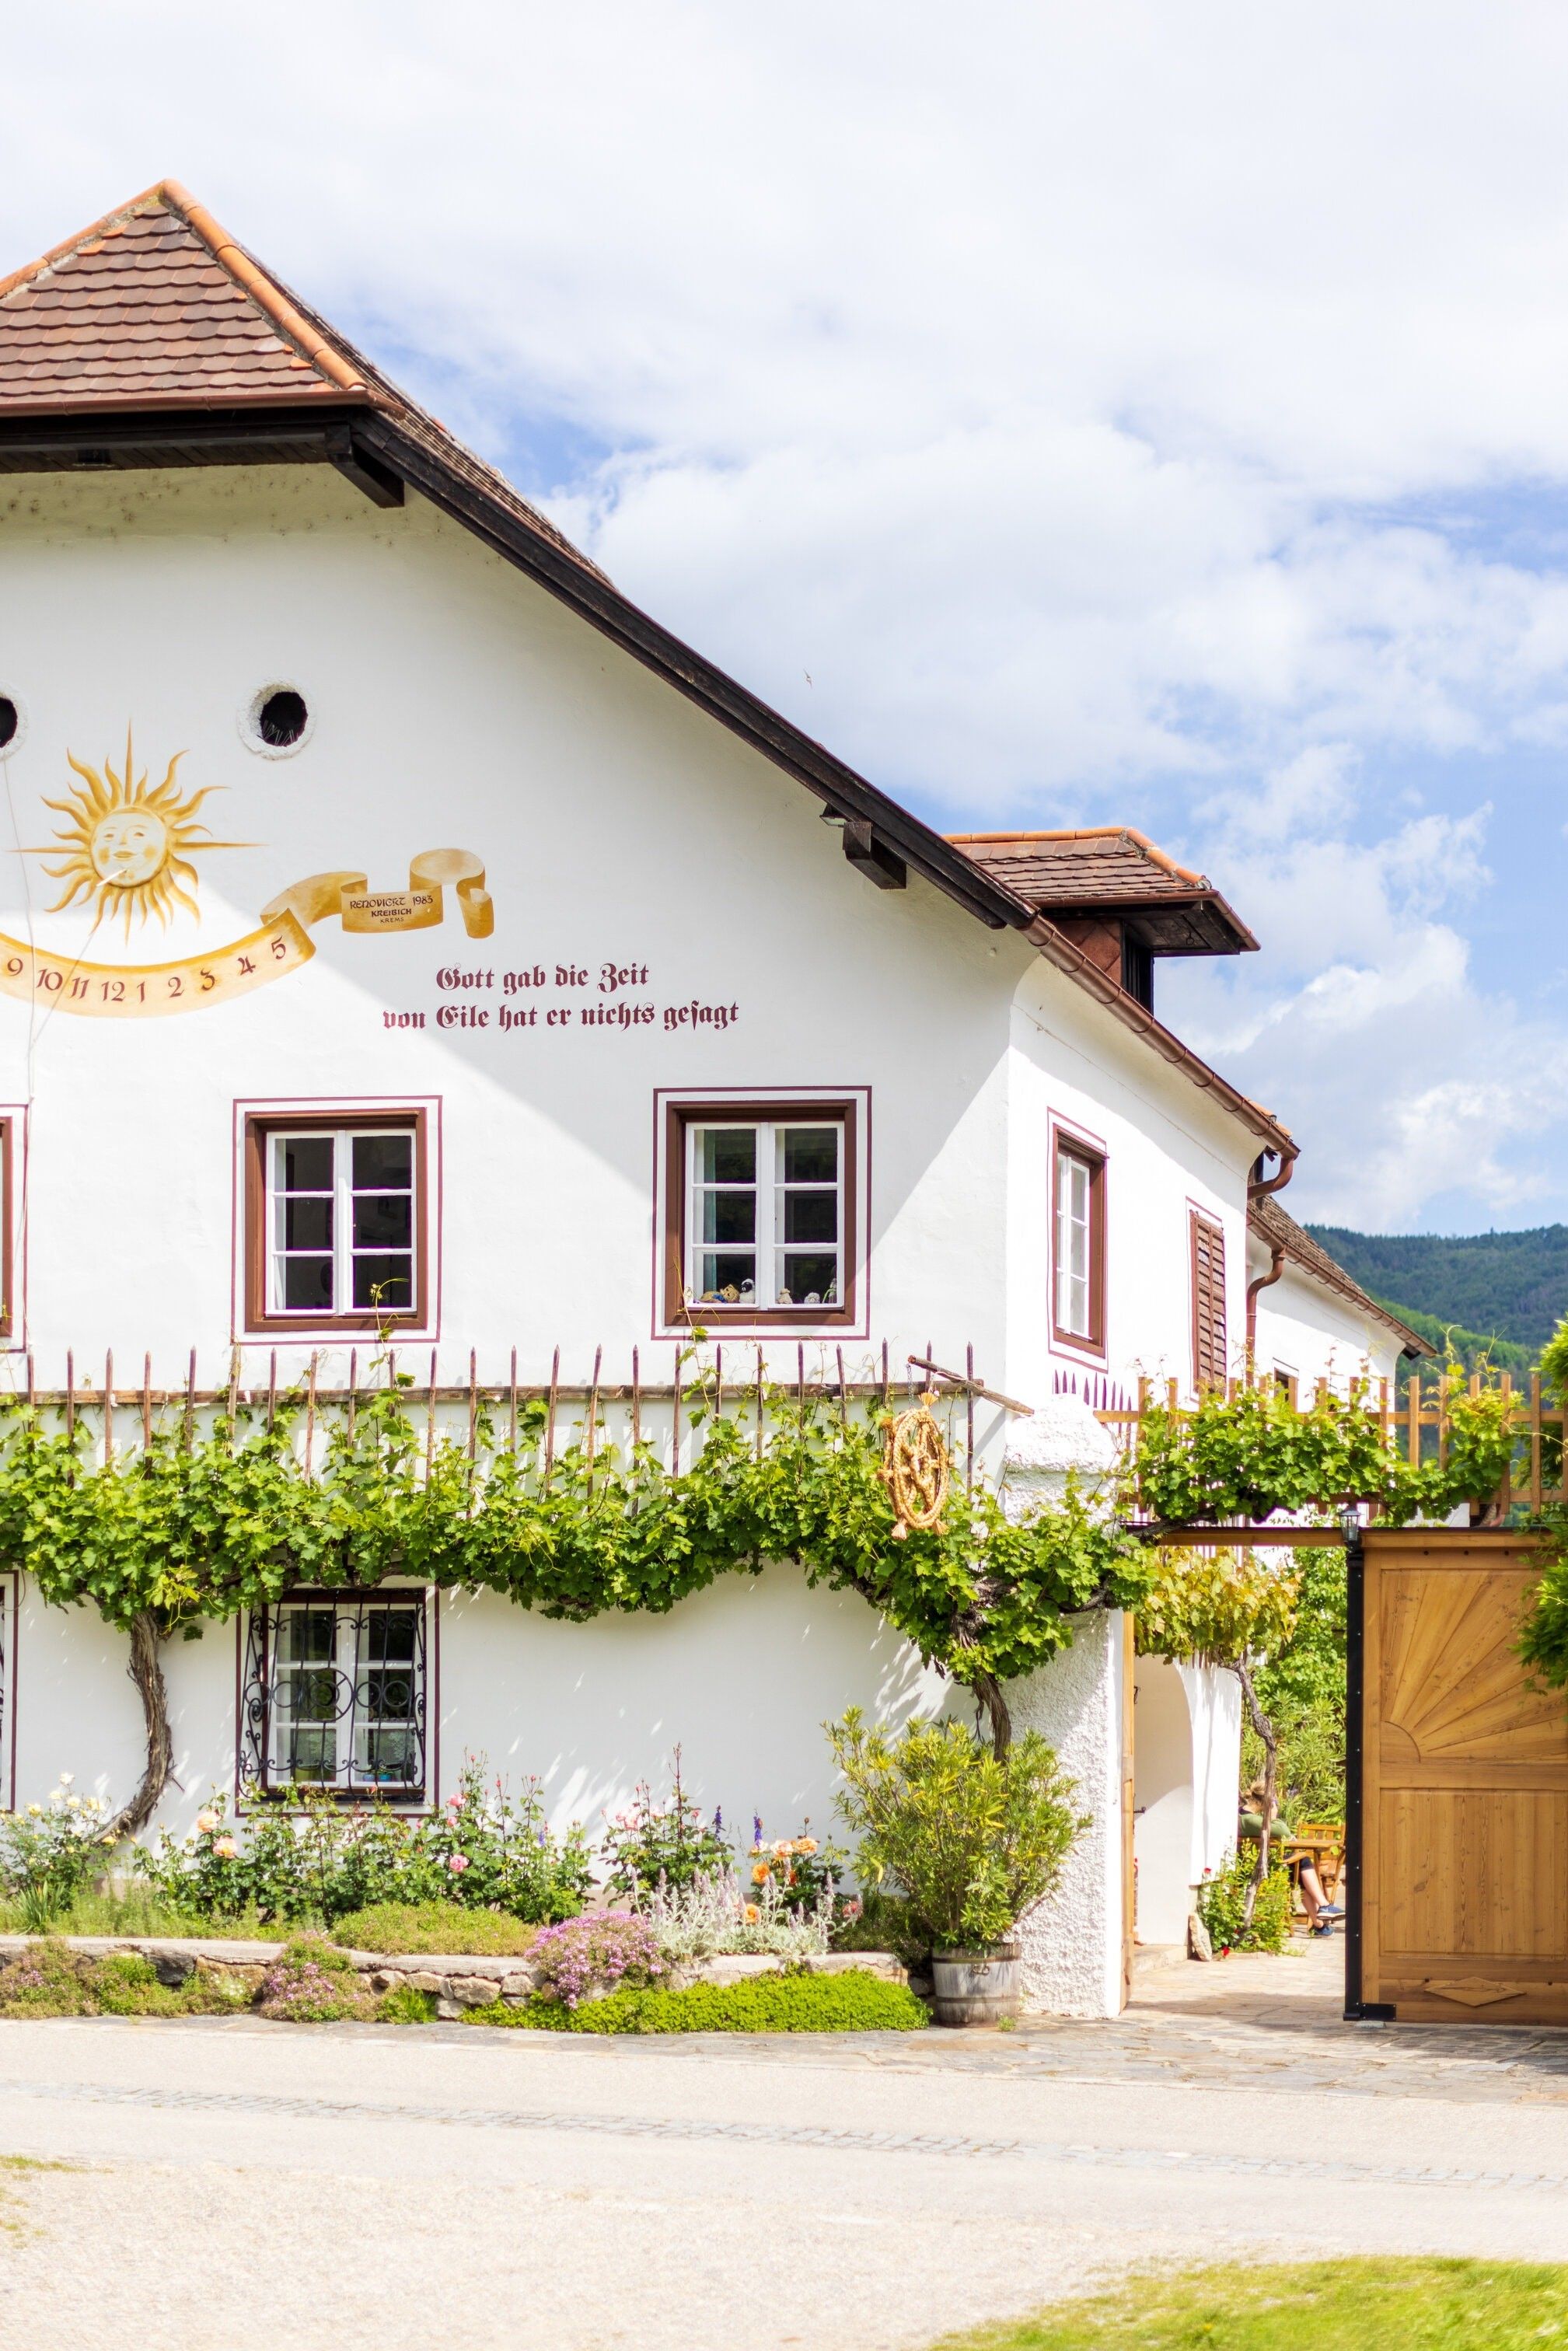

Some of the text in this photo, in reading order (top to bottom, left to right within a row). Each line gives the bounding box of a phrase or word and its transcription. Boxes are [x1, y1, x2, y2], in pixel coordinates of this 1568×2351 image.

[371, 908, 412, 917] KREIBICH
[7, 935, 286, 1003] 9 10 11 12 1 2 3 4 5
[436, 962, 649, 995] Gott gab die Zeit
[382, 1009, 427, 1029] von
[436, 1004, 490, 1029] Eile
[498, 1004, 538, 1032] hat
[547, 1008, 572, 1026] er
[581, 1001, 655, 1032] nichts
